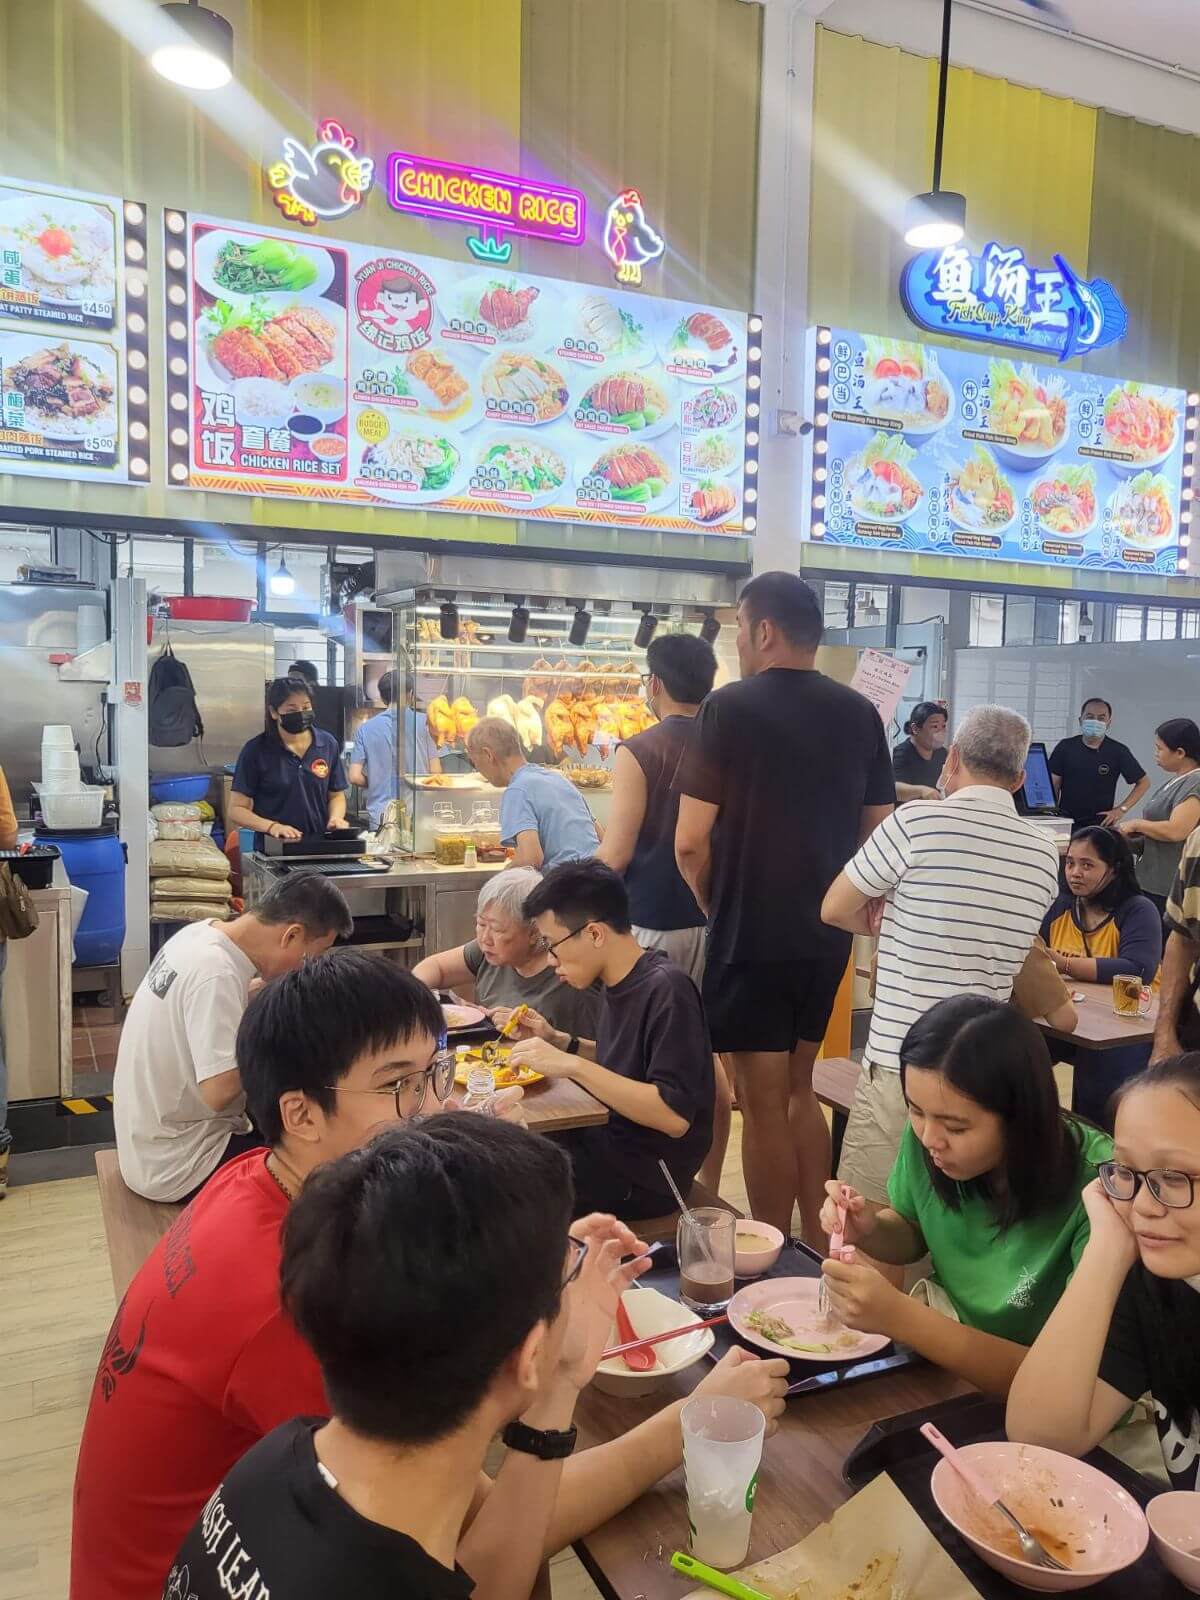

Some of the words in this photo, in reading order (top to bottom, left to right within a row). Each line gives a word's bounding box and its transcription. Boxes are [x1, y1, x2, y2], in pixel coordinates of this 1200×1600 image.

[399, 169, 512, 215] CHICKEN
[519, 193, 576, 228] RICE
[357, 264, 376, 282] YUAN
[386, 259, 418, 278] CHICKEN
[417, 276, 434, 296] RICE
[932, 244, 1069, 328] 鱼汤王
[10, 304, 33, 316] PATTY
[33, 308, 66, 321] STEAMED
[67, 313, 84, 323] RICE
[948, 301, 974, 322] Fish
[975, 307, 1000, 330] Soup
[1003, 305, 1034, 332] King
[834, 343, 851, 402] 鲜巴当
[853, 353, 866, 409] 鱼汤王
[963, 382, 977, 418] 炸鱼
[979, 374, 991, 429] 鱼汤王
[201, 391, 236, 468] 鸡饭
[358, 420, 387, 429] BUDGET
[363, 428, 382, 437] MEAL
[1093, 394, 1105, 445] 鱼汤王
[24, 447, 44, 458] PORK
[45, 450, 77, 461] STEAMED
[78, 453, 94, 463] RICE
[242, 425, 292, 453] 套餐
[240, 454, 289, 471] CHICKEN
[293, 459, 319, 473] RICE
[321, 461, 342, 475] SET
